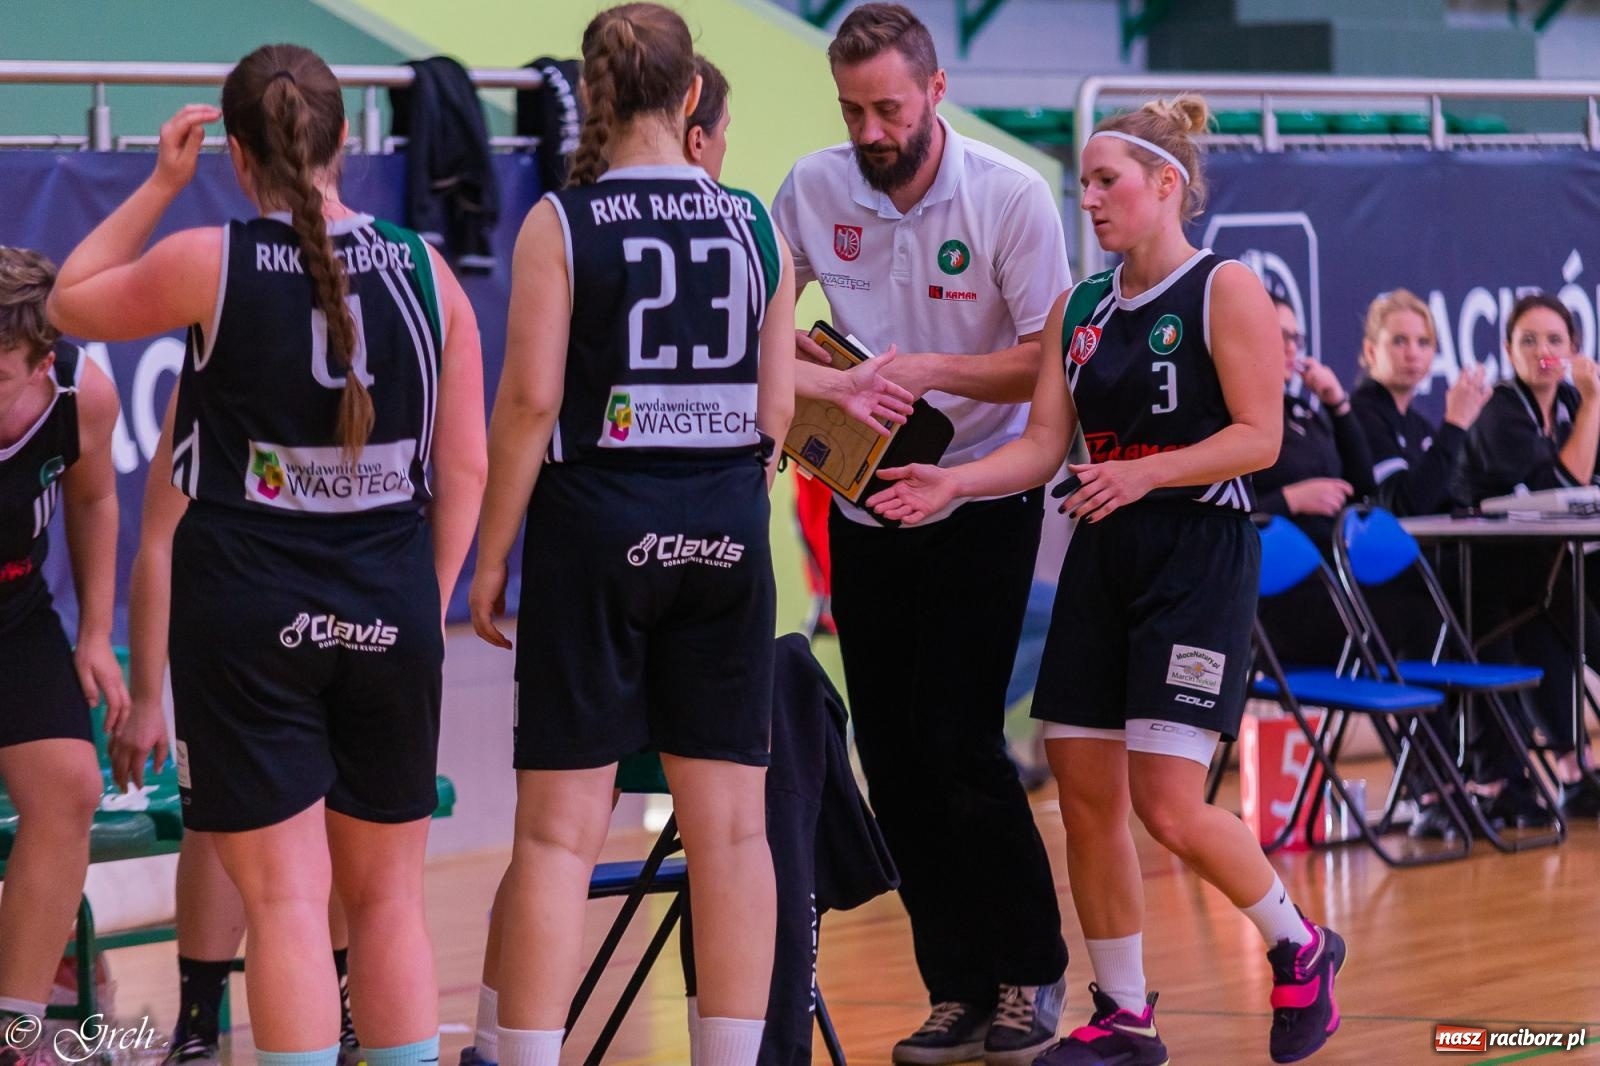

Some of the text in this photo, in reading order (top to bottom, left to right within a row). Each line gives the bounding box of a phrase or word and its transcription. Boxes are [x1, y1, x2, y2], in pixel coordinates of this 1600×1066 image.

[590, 189, 757, 225] RKK RACIBÓRZ
[256, 243, 304, 275] RKK
[622, 237, 749, 370] 23
[1151, 361, 1178, 415] 3
[635, 398, 720, 413] wydawnictwo
[635, 411, 757, 434] WAGTECH
[287, 469, 410, 498] WAGTECH
[657, 534, 745, 562] Clavis
[704, 559, 733, 568] KLUCZY
[311, 614, 399, 646] Clavis
[1171, 671, 1195, 682] Marcin
[1174, 693, 1216, 709] COLO
